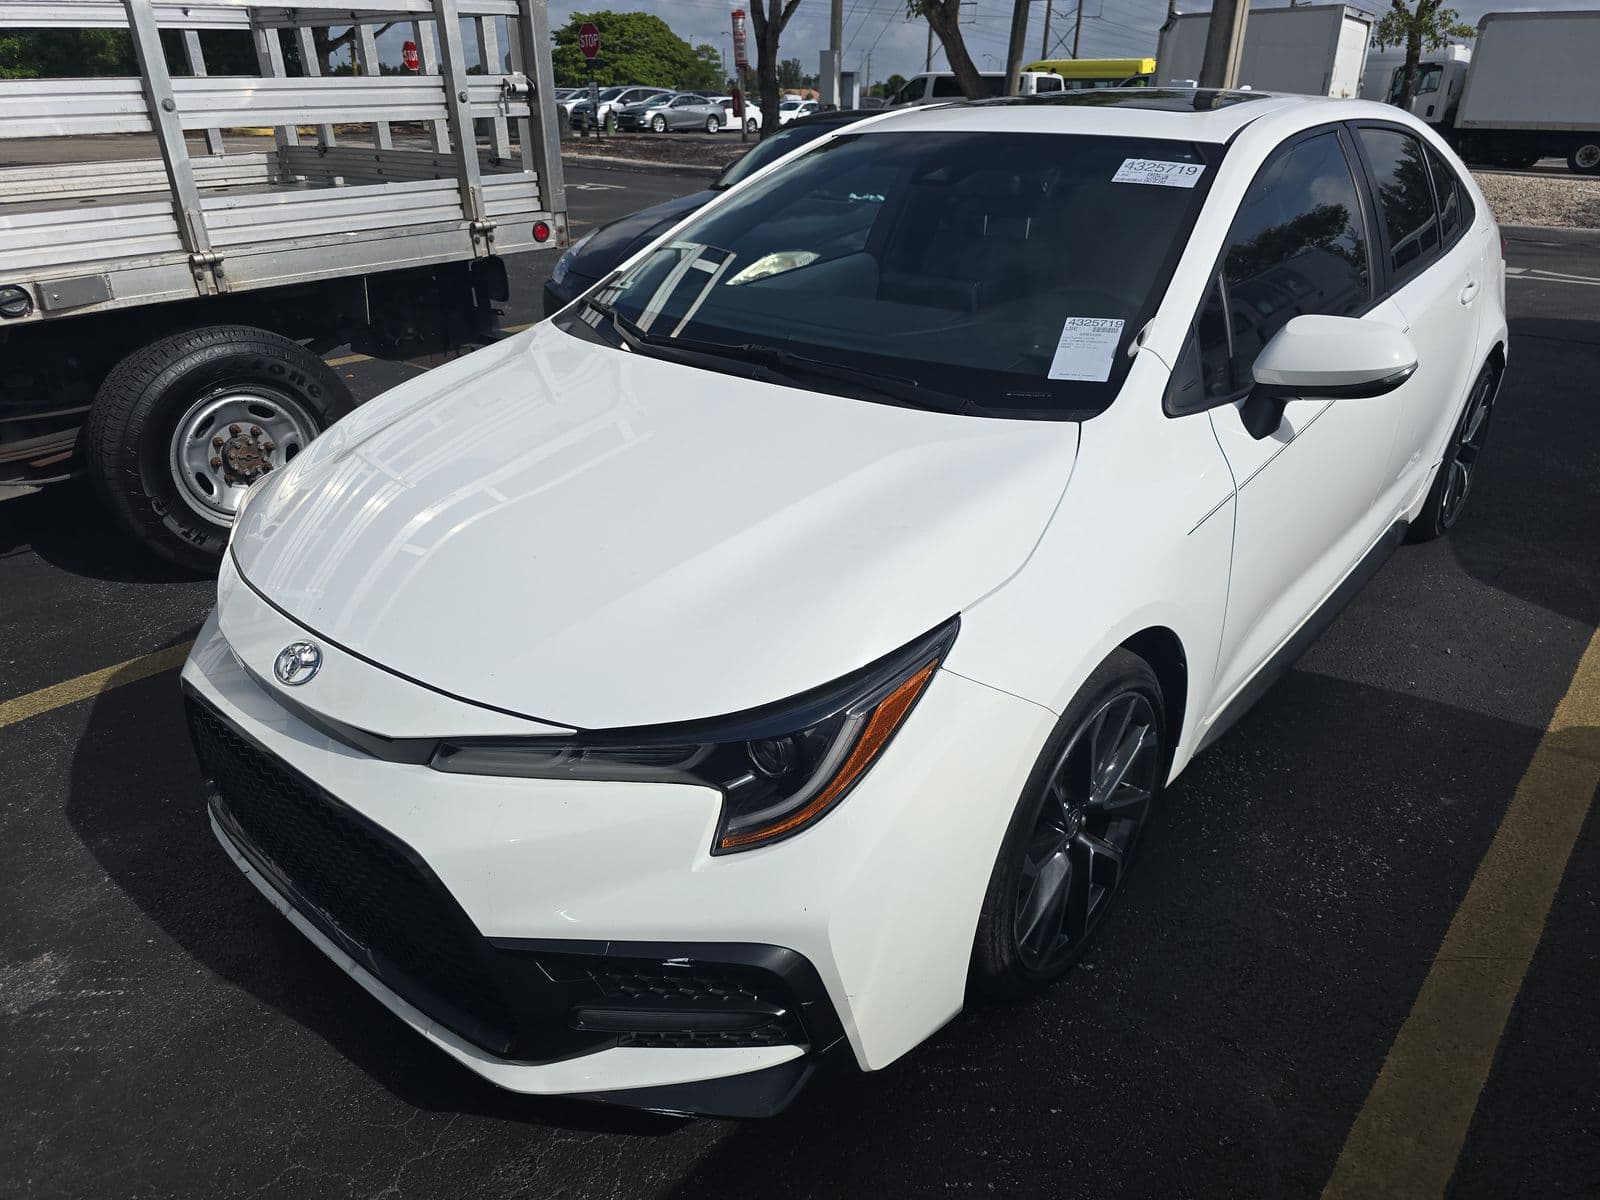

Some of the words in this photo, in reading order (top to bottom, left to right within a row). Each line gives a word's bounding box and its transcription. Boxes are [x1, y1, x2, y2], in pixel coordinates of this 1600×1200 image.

[580, 33, 599, 48] STOP
[1124, 161, 1198, 176] 4325719
[1068, 318, 1124, 328] 4325719
